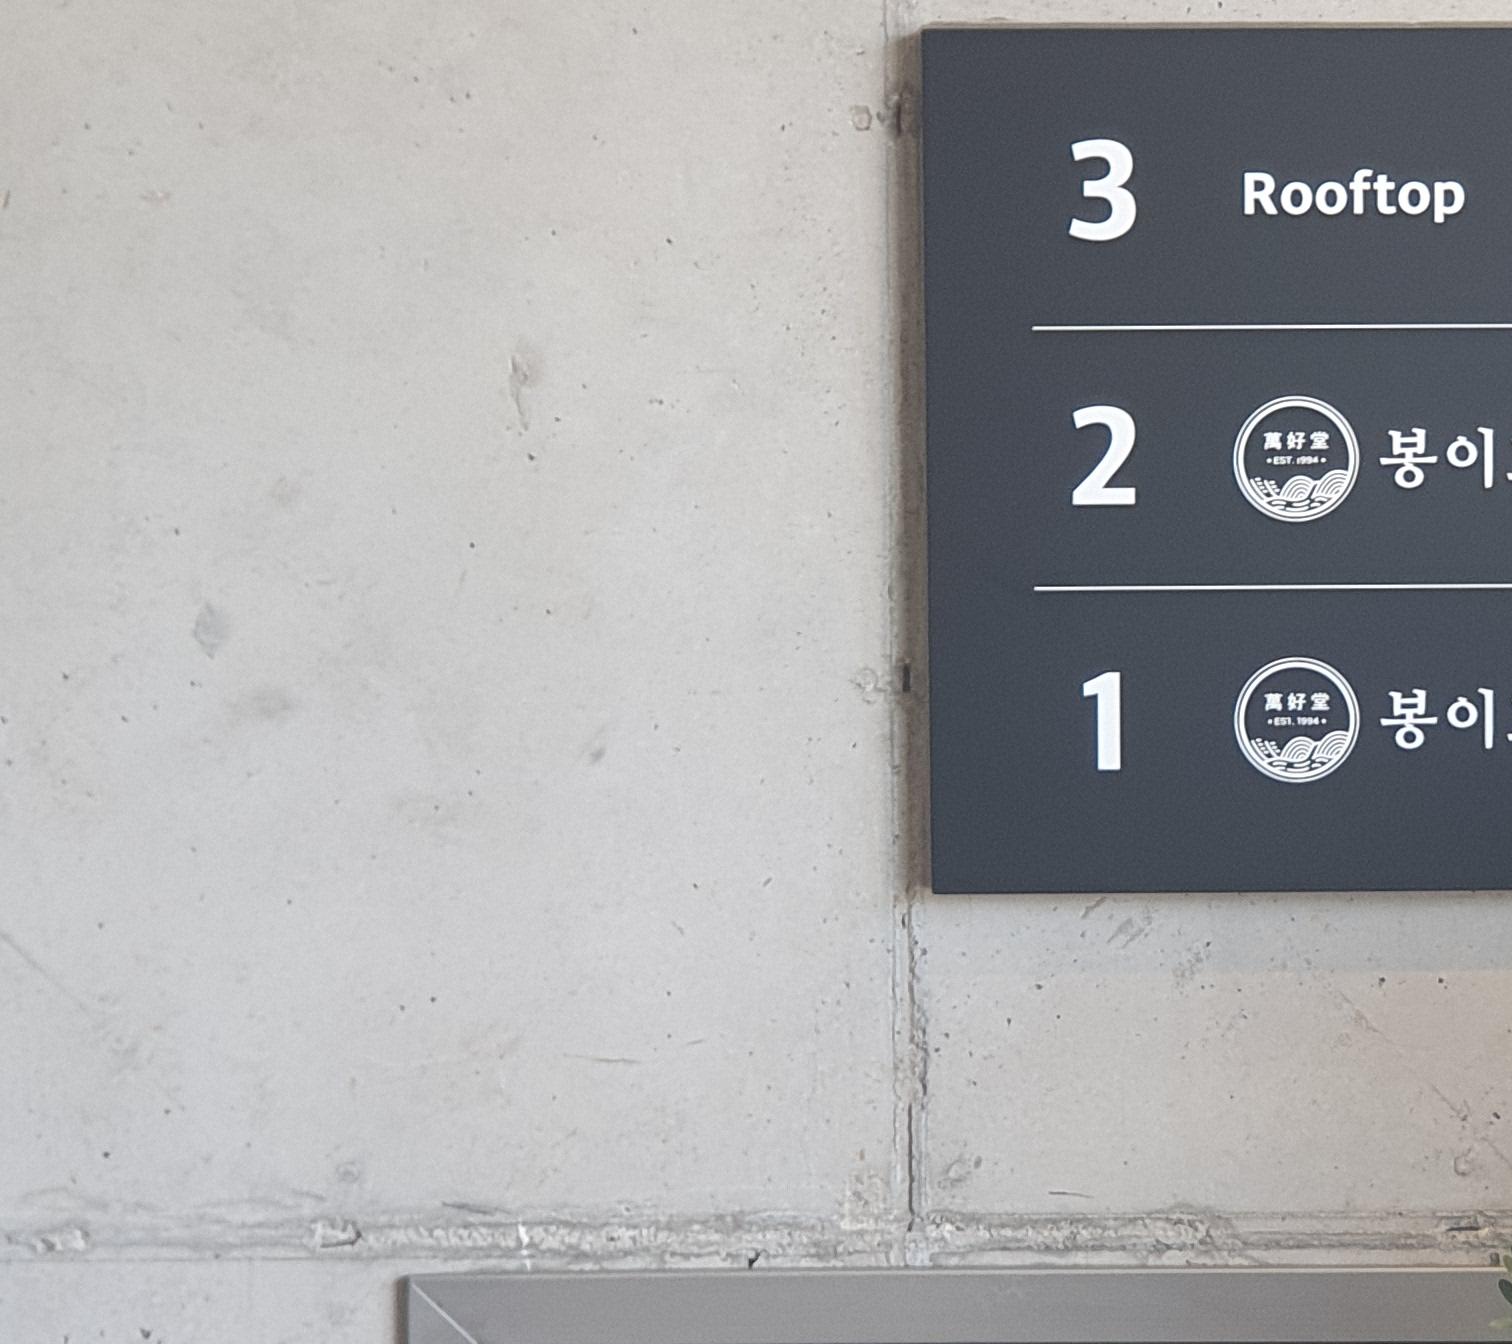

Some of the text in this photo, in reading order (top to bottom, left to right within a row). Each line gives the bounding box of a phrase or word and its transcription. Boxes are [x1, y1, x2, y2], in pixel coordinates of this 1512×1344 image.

[1068, 138, 1466, 242] 3 Rooftop
[1071, 405, 1137, 506] 2
[1082, 671, 1122, 771] 1
